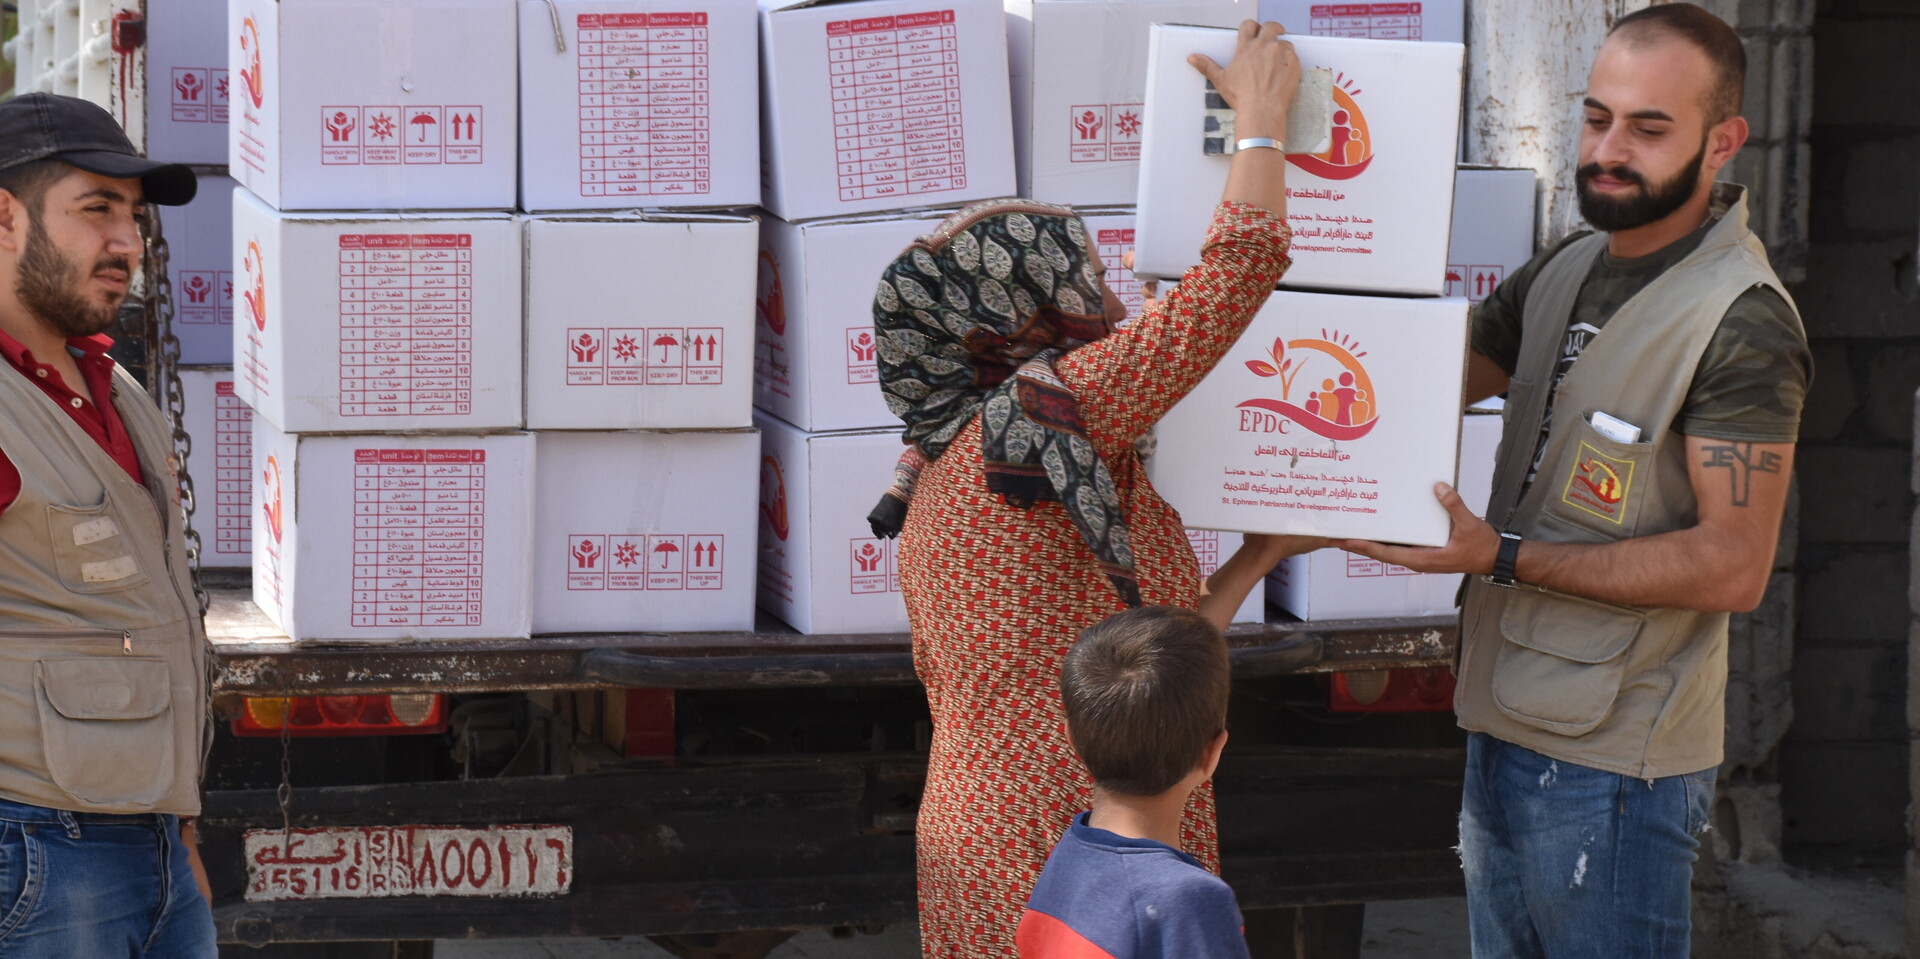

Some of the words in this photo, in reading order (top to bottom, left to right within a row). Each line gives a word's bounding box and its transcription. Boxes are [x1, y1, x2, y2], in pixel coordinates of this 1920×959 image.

[1291, 244, 1335, 253] Development
[1336, 246, 1373, 254] Committee
[1238, 409, 1291, 435] EPDC
[1338, 450, 1351, 462] من
[1260, 500, 1296, 508] Patriarchal
[1297, 502, 1340, 512] Development
[1341, 505, 1378, 514] Committee
